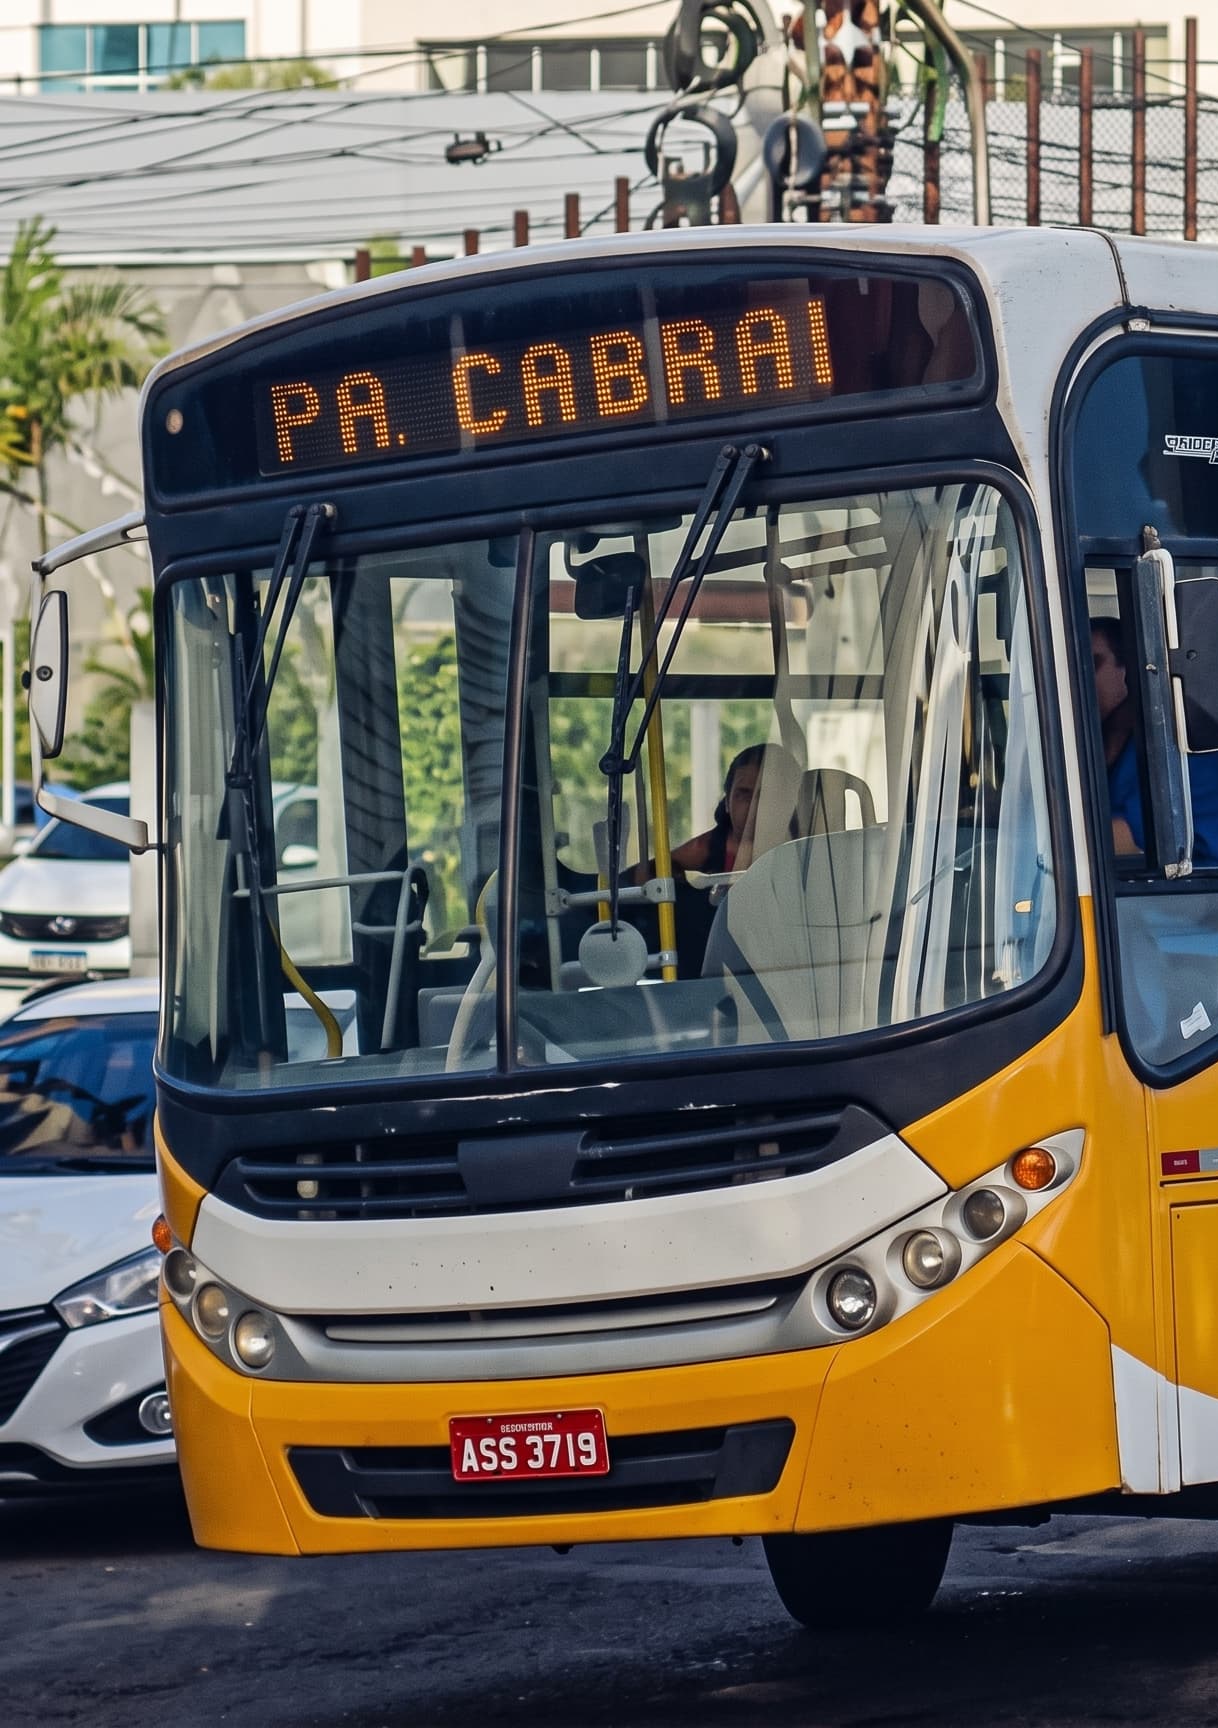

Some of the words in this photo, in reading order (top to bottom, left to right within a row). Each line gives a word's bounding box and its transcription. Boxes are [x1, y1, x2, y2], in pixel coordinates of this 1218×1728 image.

[270, 371, 405, 463] PA.
[461, 1436, 518, 1473] ASS
[525, 1432, 598, 1470] 3719
